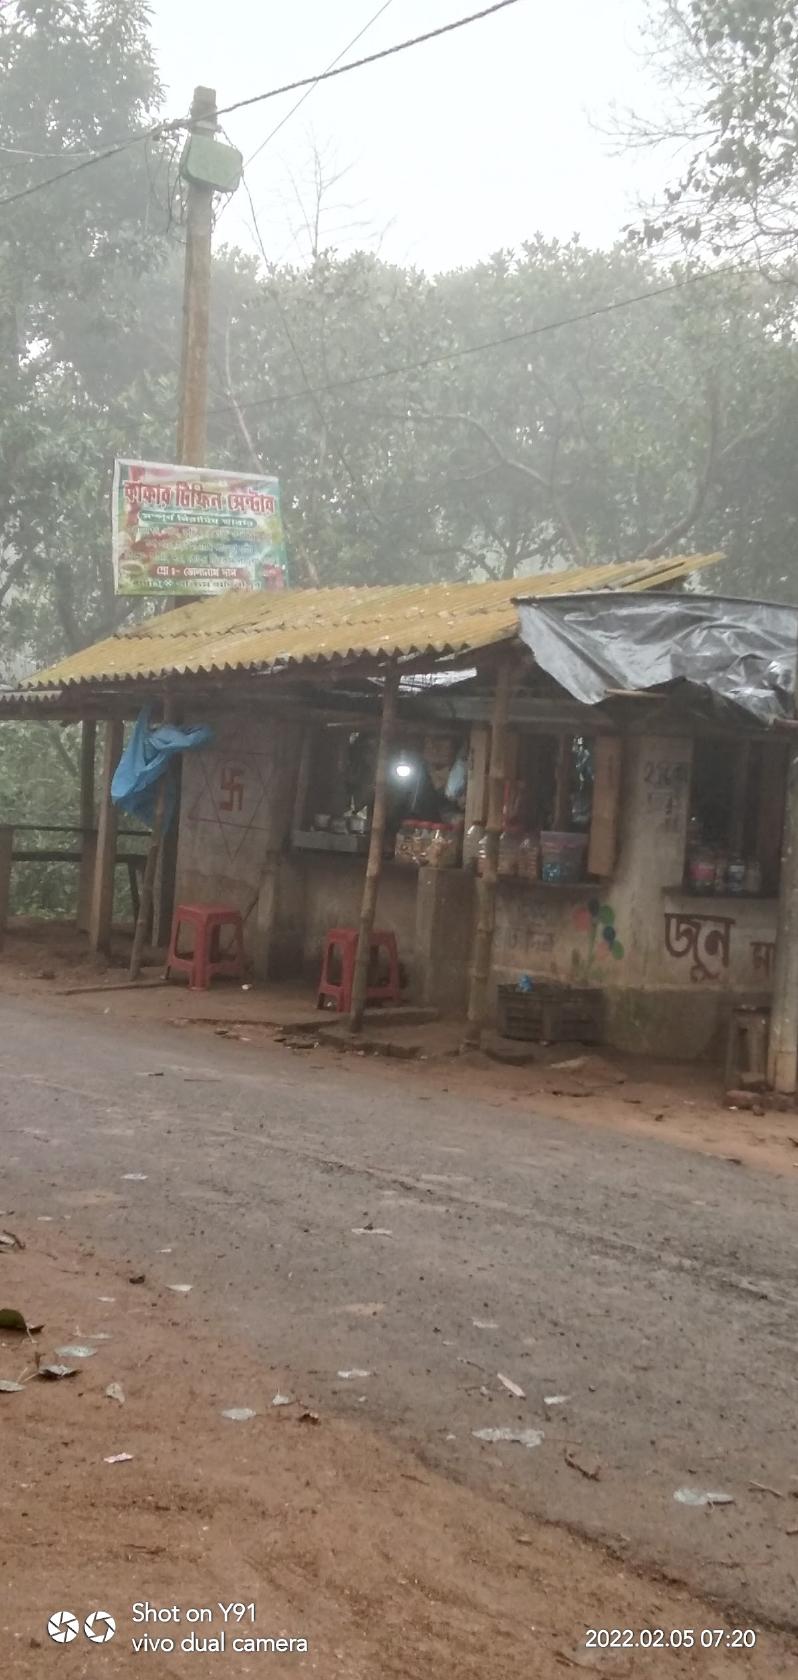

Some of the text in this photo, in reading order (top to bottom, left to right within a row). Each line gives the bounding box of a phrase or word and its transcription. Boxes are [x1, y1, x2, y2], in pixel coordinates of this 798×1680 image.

[176, 481, 222, 510] টিফিন
[228, 490, 275, 513] সেন্টার
[664, 912, 736, 983] জুন
